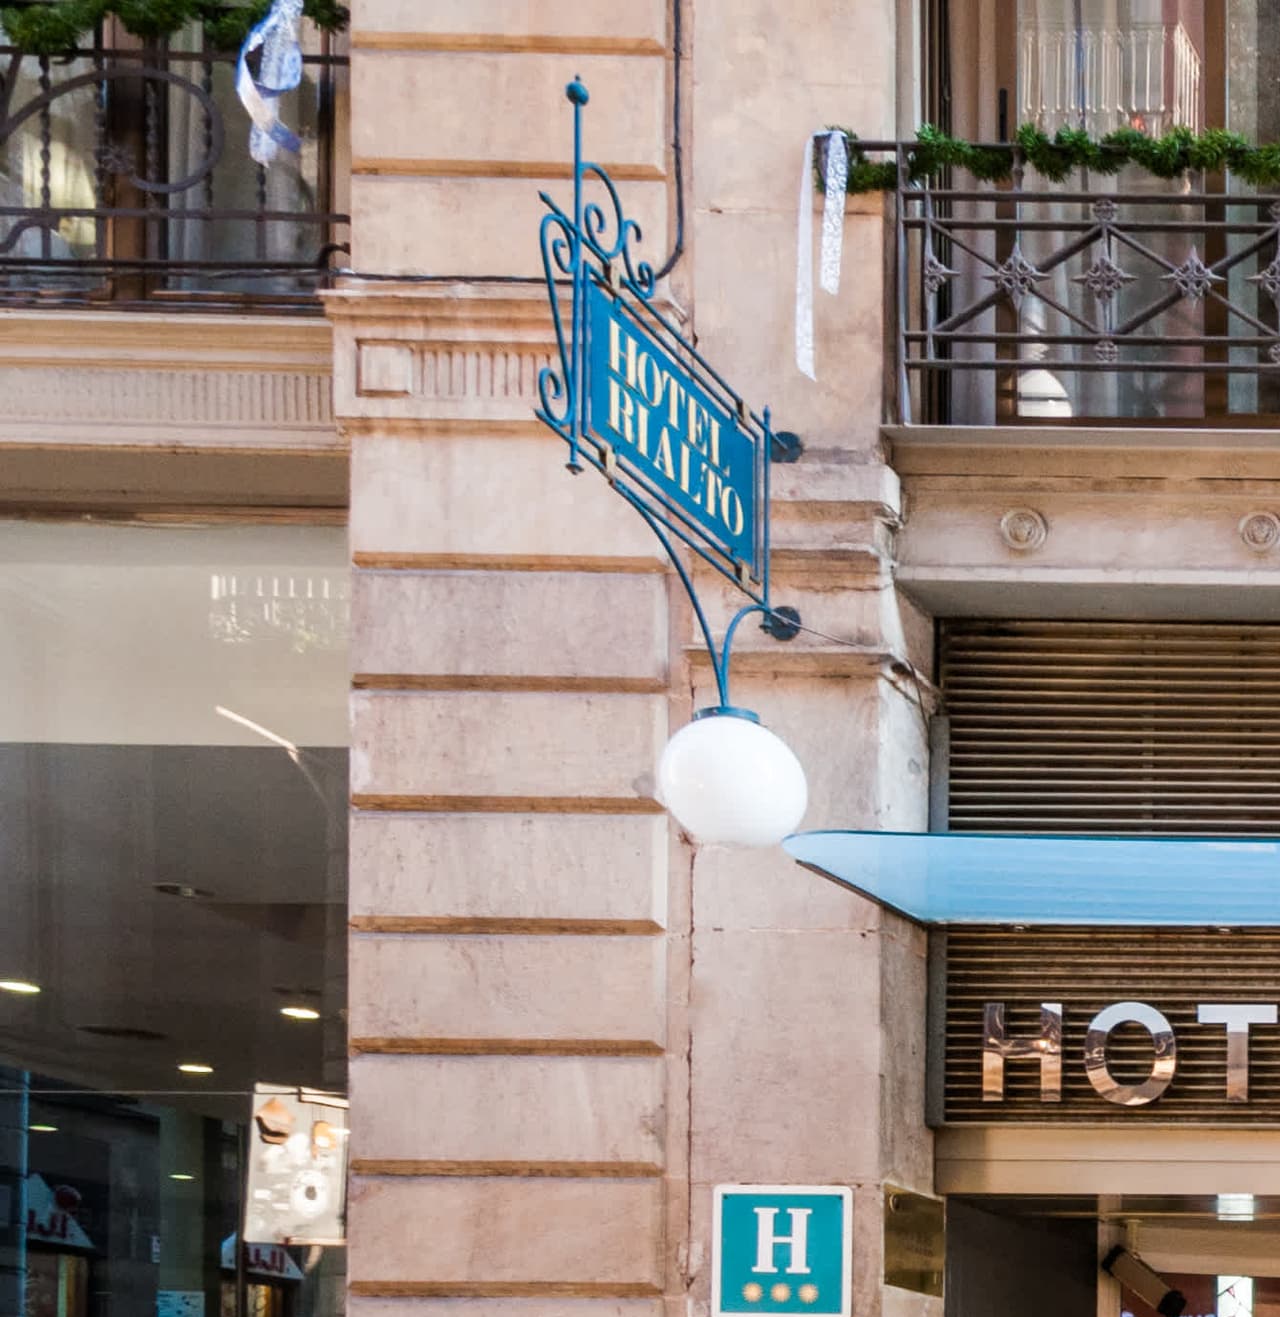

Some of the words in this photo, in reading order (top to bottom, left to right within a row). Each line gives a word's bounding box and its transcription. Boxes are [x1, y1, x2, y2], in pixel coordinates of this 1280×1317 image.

[608, 376, 744, 536] RIALTO
[609, 318, 730, 477] HOTEL
[751, 1206, 813, 1274] H
